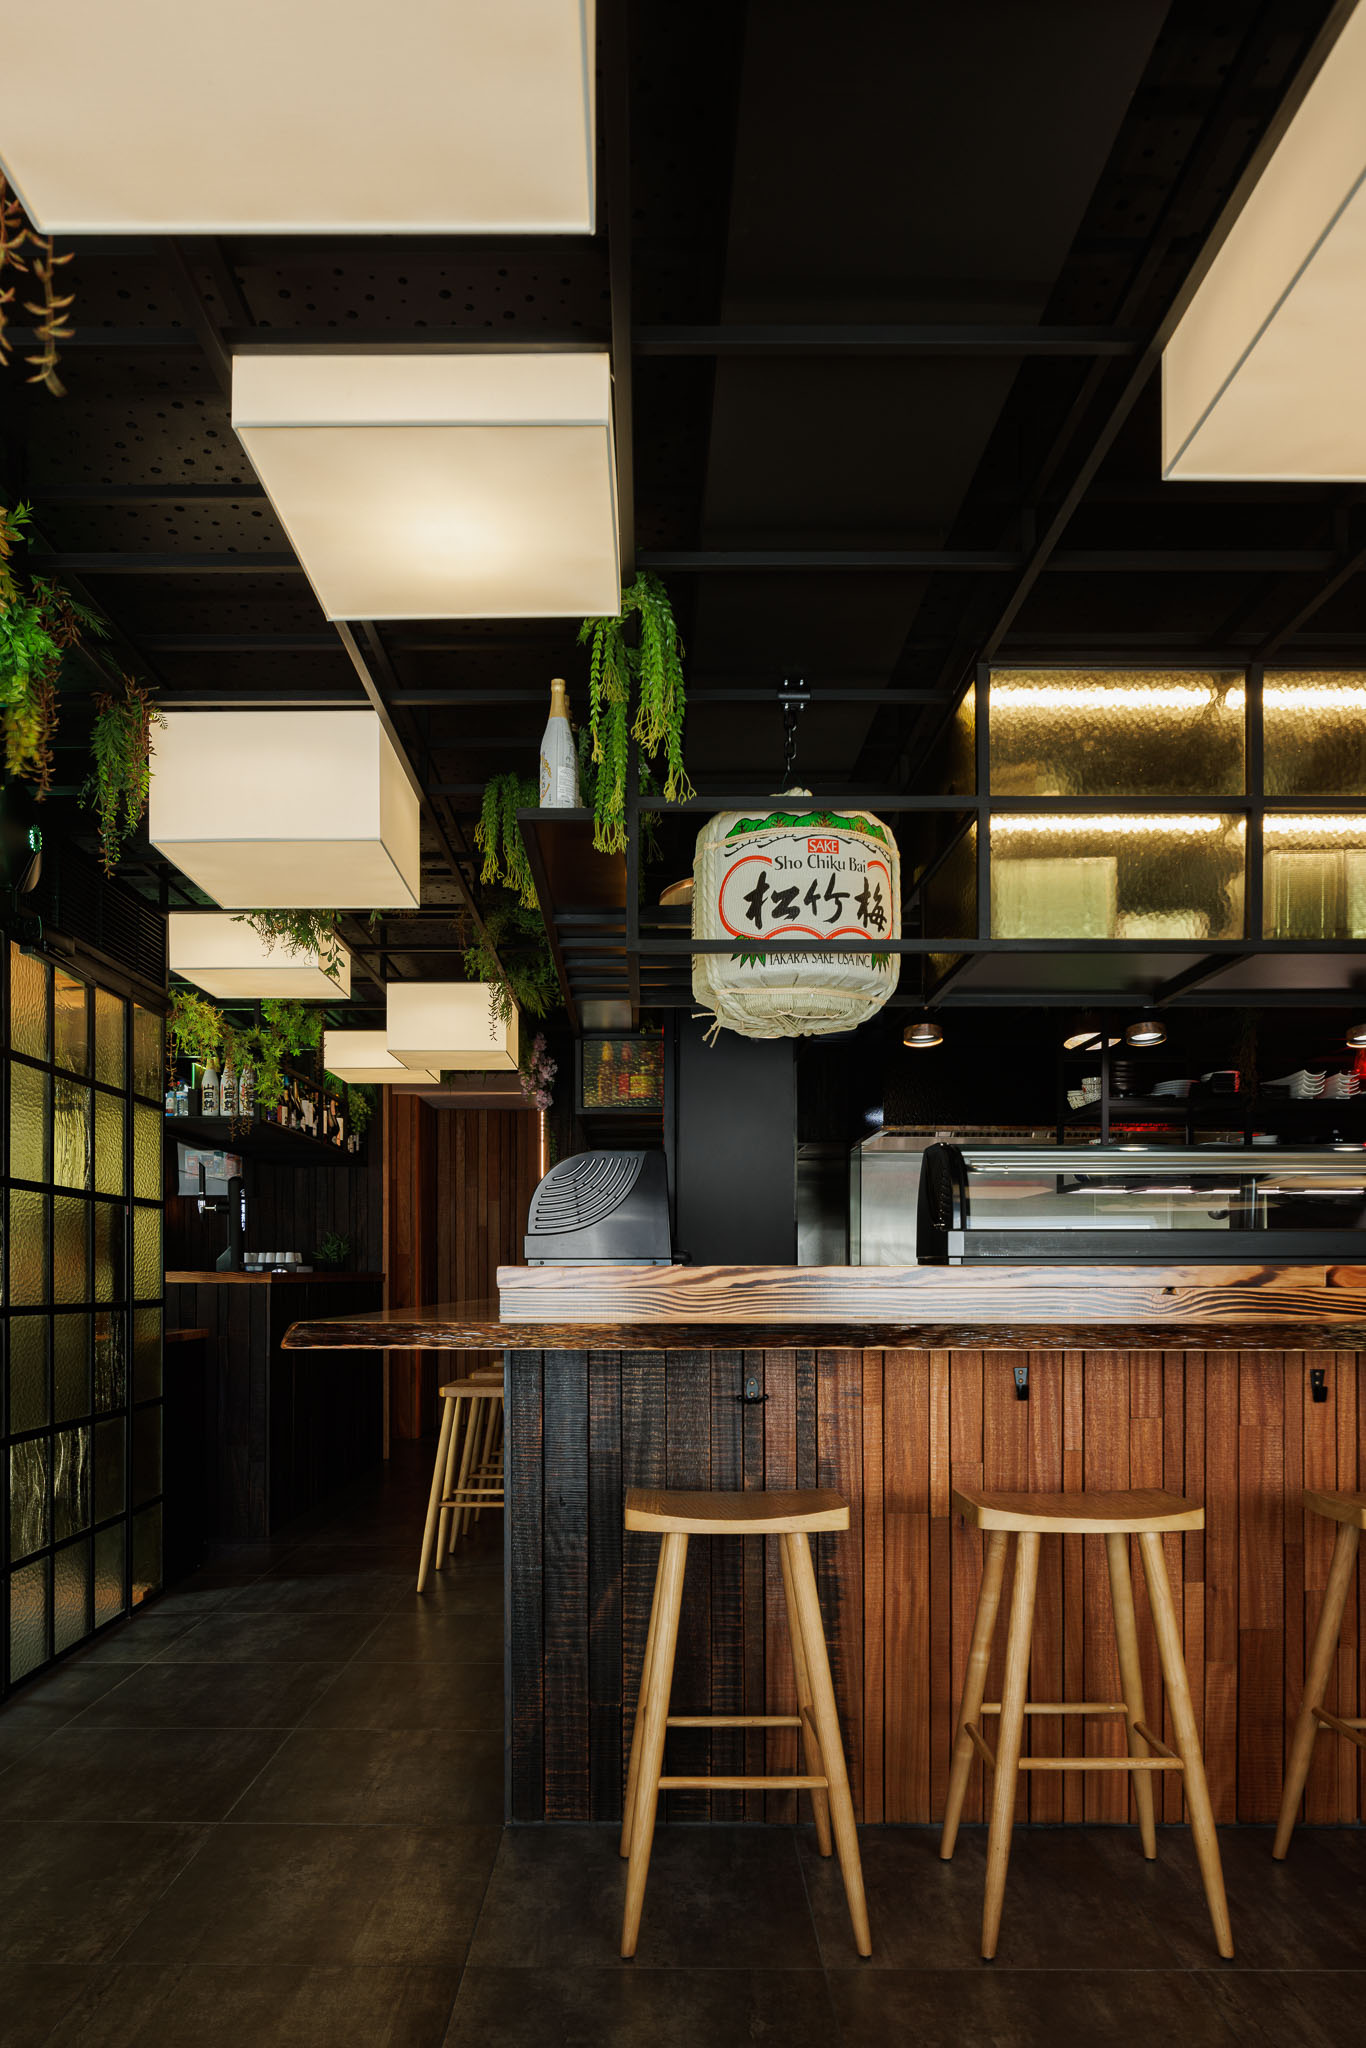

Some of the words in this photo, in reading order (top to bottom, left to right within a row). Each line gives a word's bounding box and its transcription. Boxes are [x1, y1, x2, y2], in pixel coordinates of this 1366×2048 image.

[808, 839, 838, 853] SAKE
[774, 855, 803, 871] Sho
[807, 853, 846, 872] Chiku
[849, 857, 866, 873] Bai
[743, 870, 888, 933] 松竹梅
[768, 952, 809, 966] TAKARA
[811, 952, 835, 965] SAKE
[837, 952, 855, 966] USA
[856, 953, 871, 968] INC
